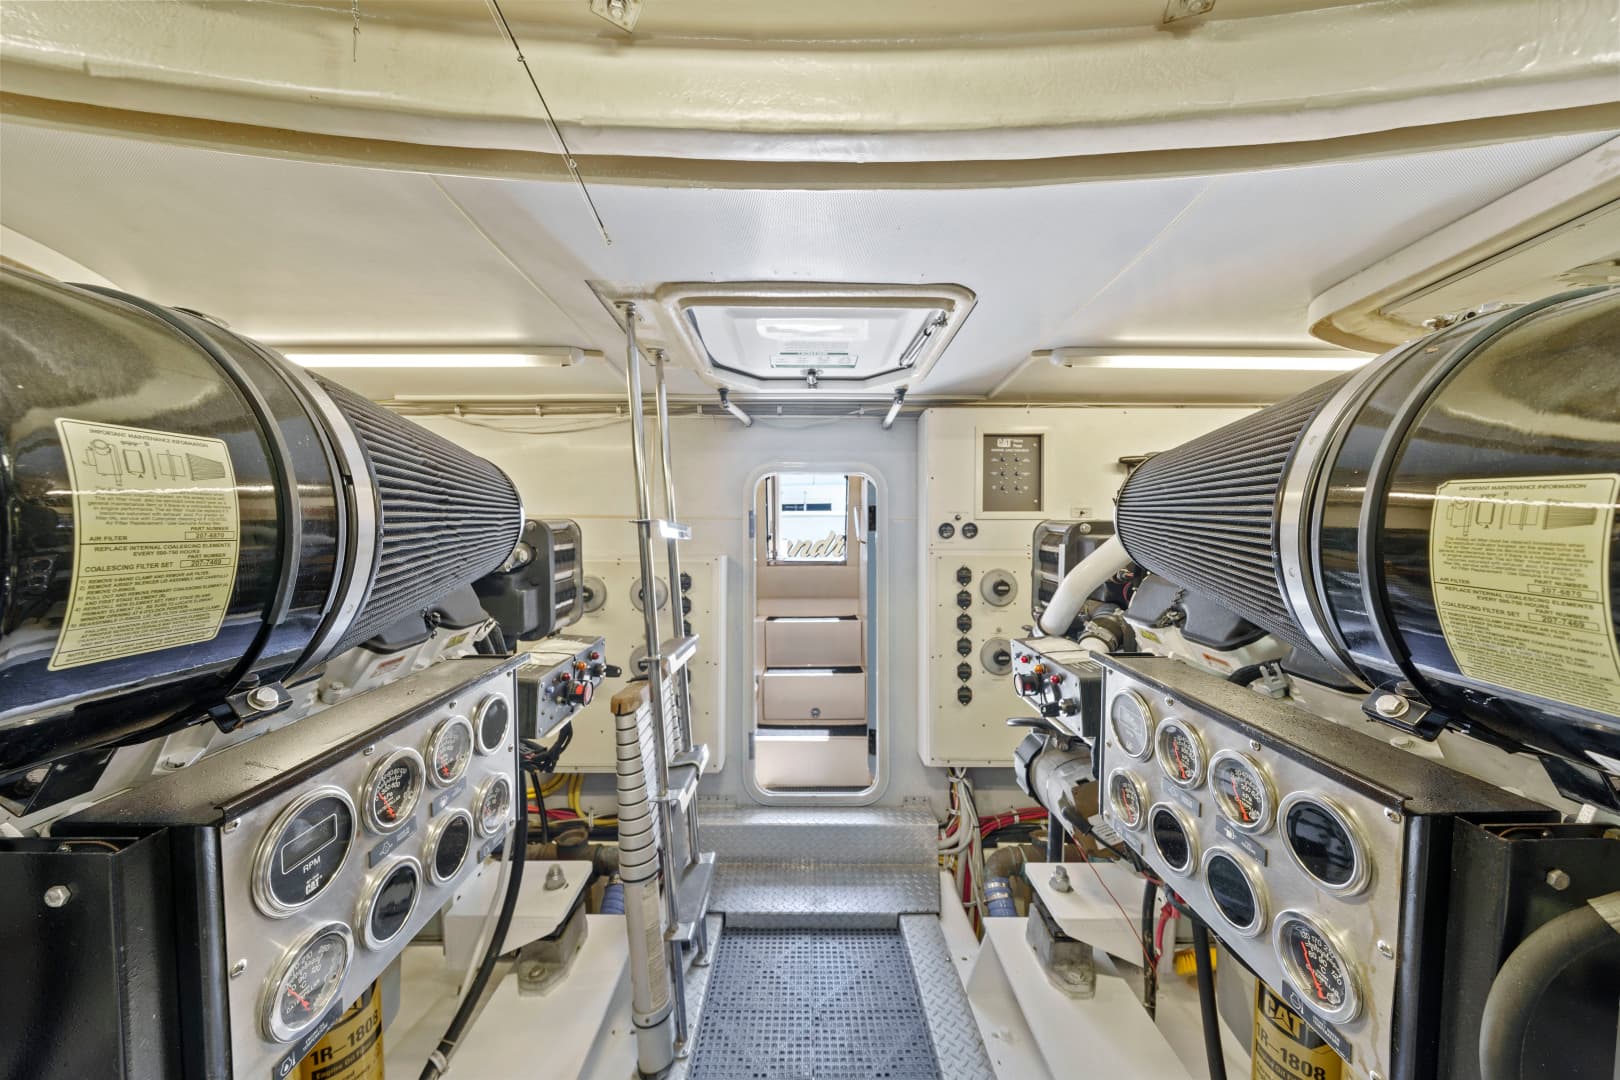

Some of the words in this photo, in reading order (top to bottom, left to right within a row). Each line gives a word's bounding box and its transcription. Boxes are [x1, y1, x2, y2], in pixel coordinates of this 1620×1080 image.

[84, 564, 136, 573] COALESCING
[136, 562, 160, 571] FILTER
[161, 561, 175, 569] SET
[1554, 580, 1589, 589] NUMBER
[1472, 589, 1504, 599] INTERNAL
[1441, 600, 1482, 612] COALESCING
[1482, 606, 1505, 616] FILTER
[1535, 607, 1554, 615] PART
[303, 855, 321, 874] RPM
[305, 878, 320, 896] CAT
[1264, 993, 1305, 1040] CAT
